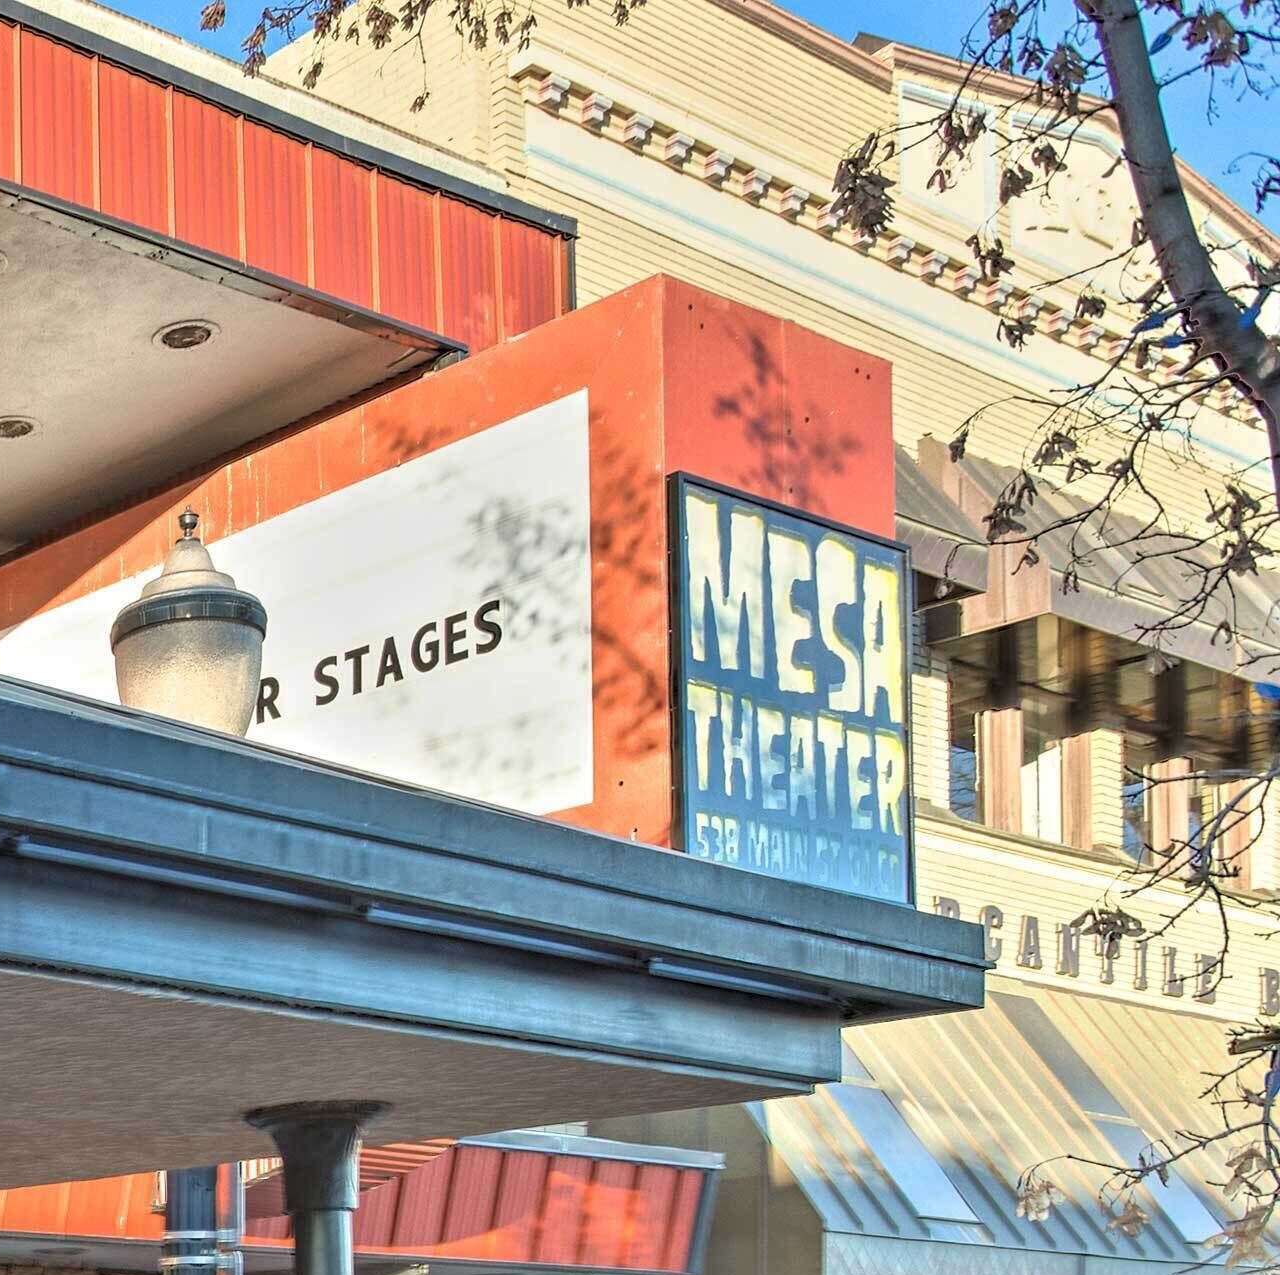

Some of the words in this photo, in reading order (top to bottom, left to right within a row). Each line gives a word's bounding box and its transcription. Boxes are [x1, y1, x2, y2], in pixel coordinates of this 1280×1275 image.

[314, 600, 502, 706] STAGES
[686, 492, 903, 723] MESA
[687, 680, 906, 836] THEATER
[695, 812, 739, 863] 538
[747, 820, 808, 873] MAIN
